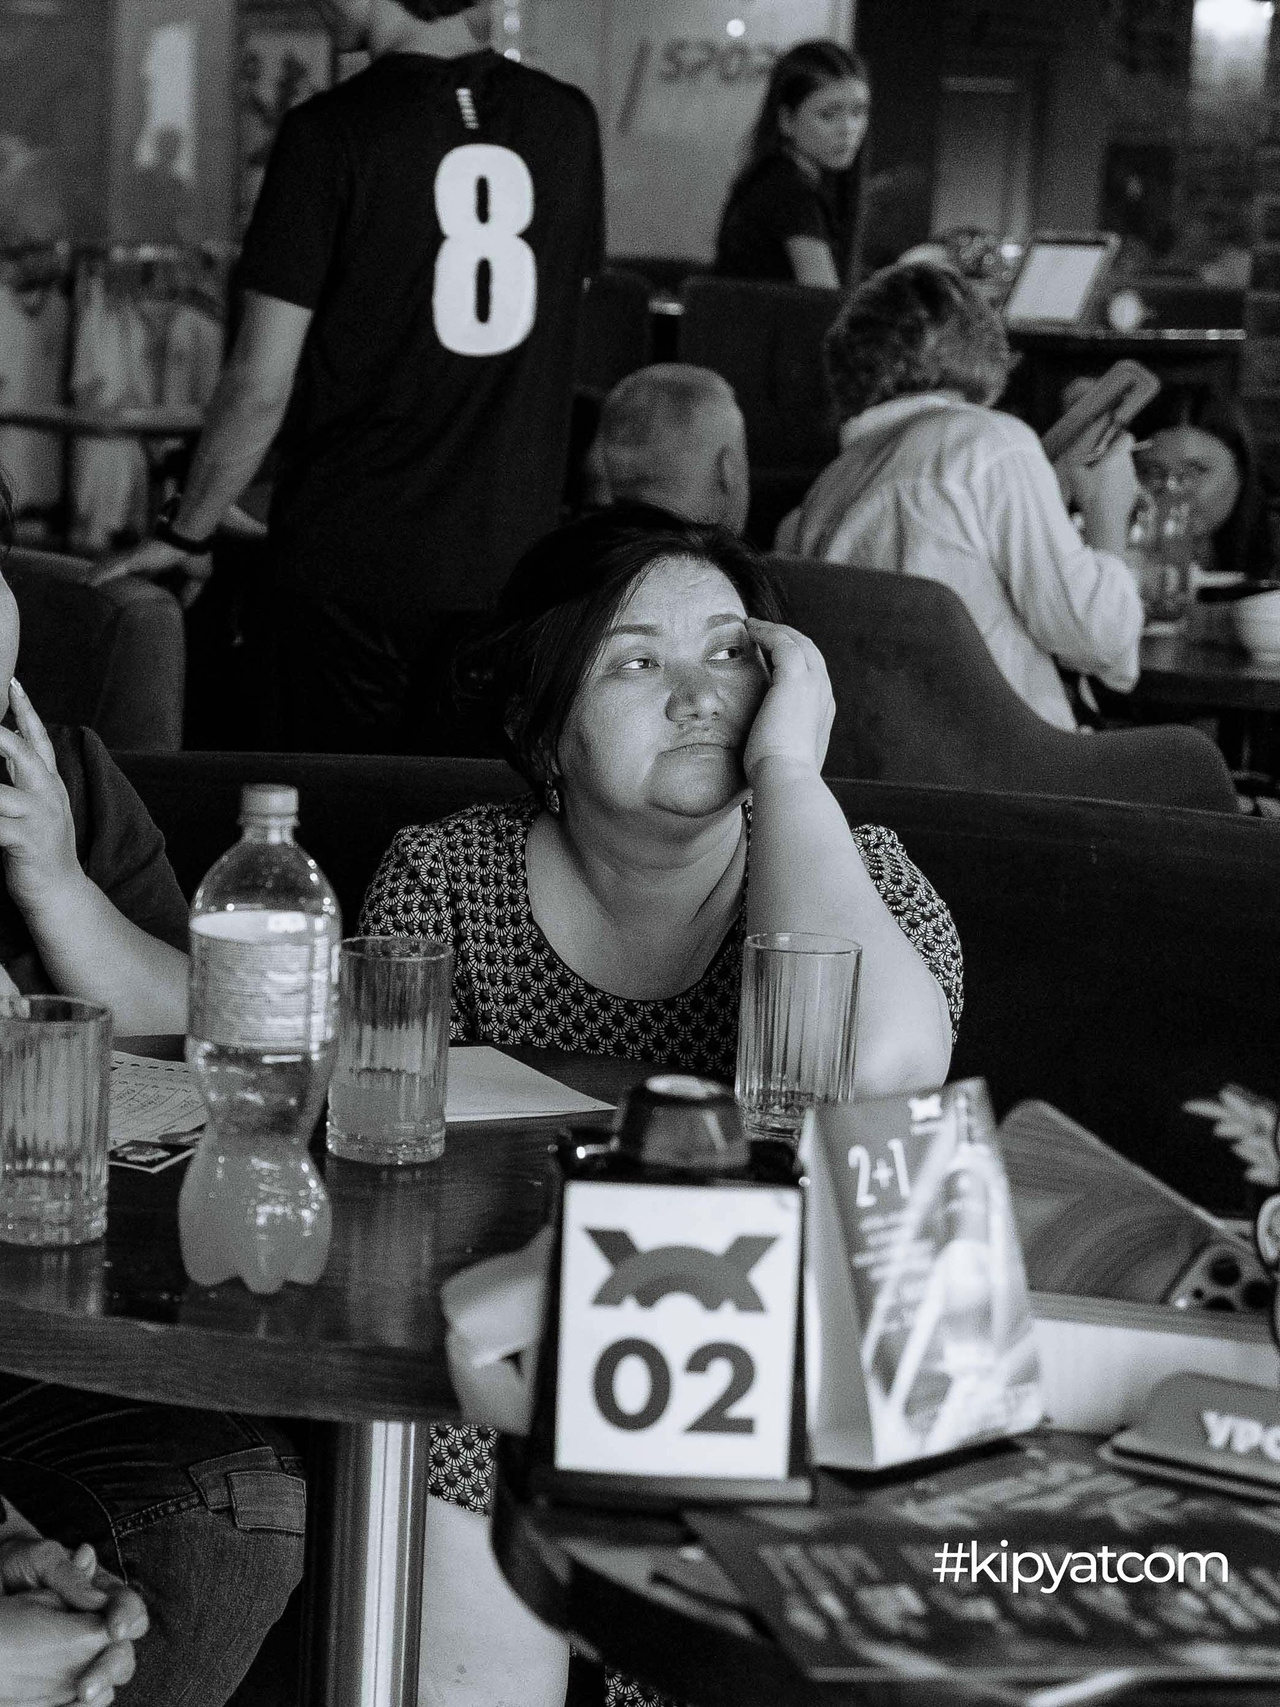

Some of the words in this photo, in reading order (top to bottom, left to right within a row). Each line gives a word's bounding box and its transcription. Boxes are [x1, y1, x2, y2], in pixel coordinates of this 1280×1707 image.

[432, 143, 538, 357] 8
[848, 1138, 912, 1207] 2+1
[593, 1338, 756, 1434] 02
